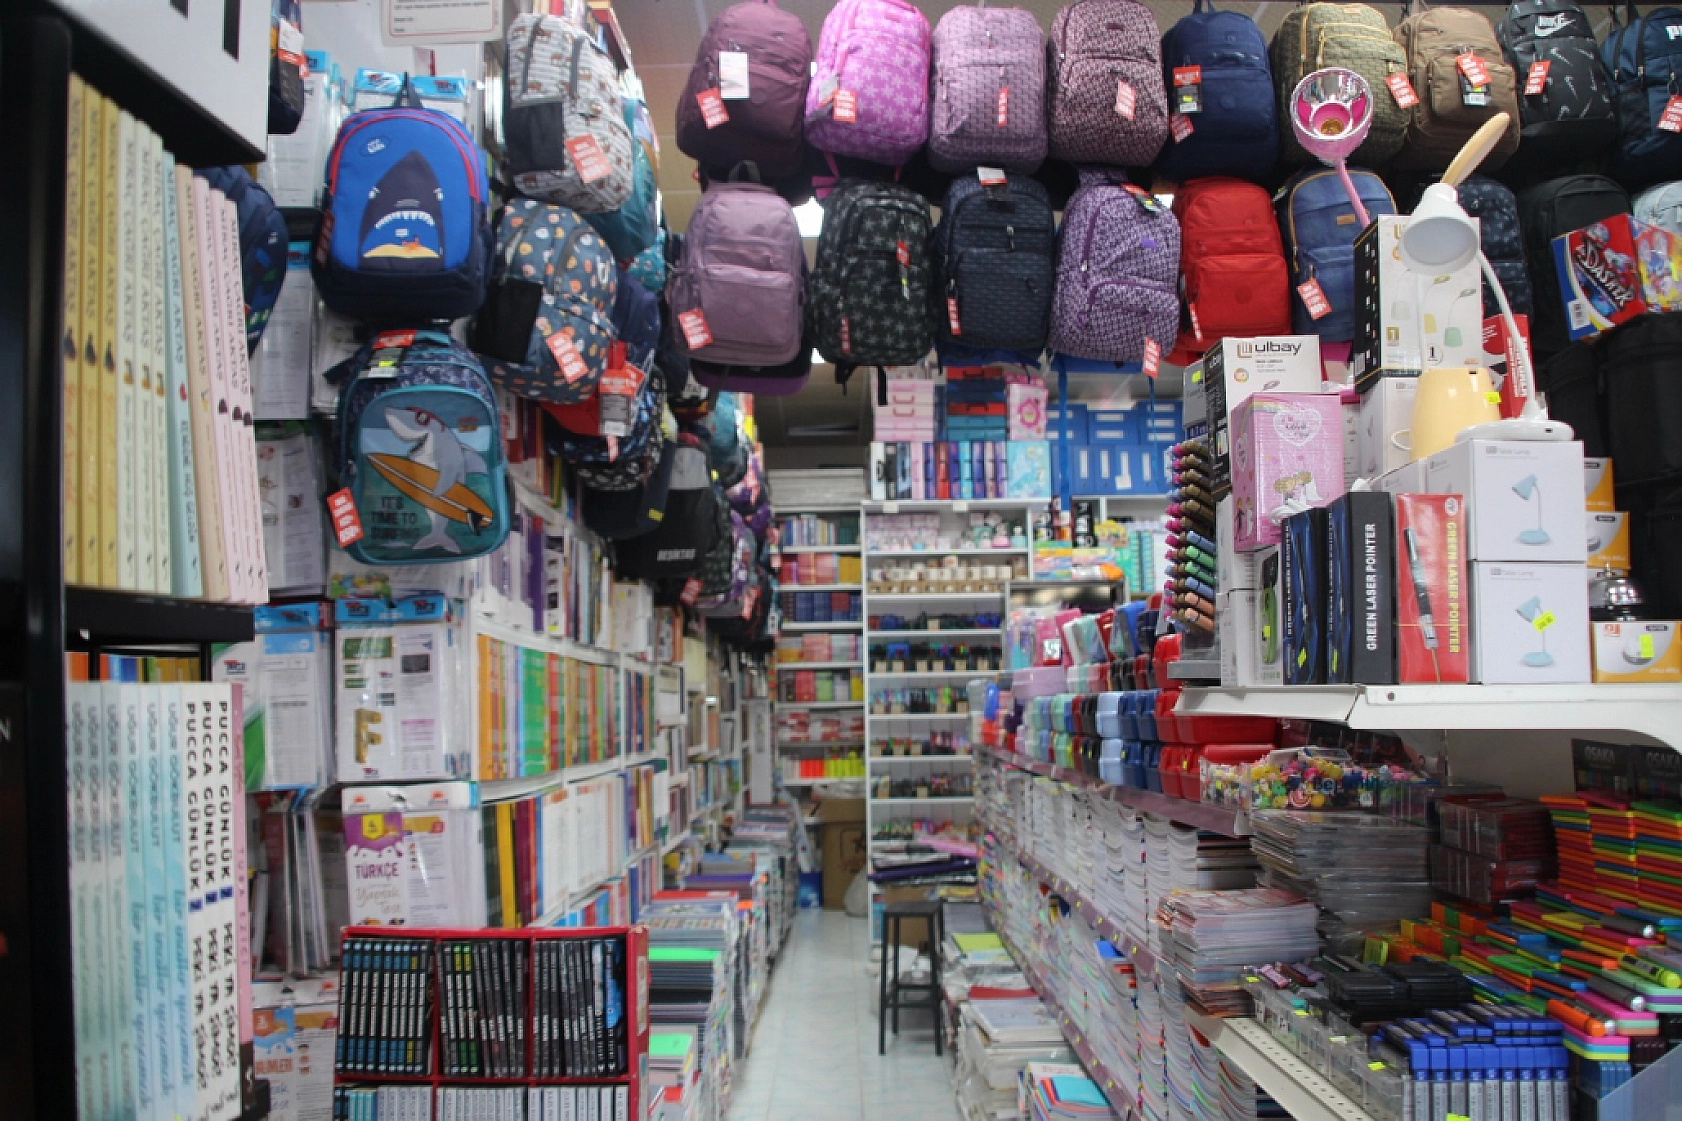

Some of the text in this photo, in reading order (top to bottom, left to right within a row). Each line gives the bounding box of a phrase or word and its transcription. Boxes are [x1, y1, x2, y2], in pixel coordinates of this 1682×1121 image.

[1537, 13, 1567, 27] NIKE
[371, 511, 417, 525] TIME TO
[1365, 523, 1378, 651] GREEN LASER POINTER
[1446, 522, 1460, 653] GREEN LASER POINTER
[186, 702, 198, 781] PUCCA
[203, 700, 212, 776] PUCCA
[219, 700, 229, 774] PUCCA
[188, 791, 201, 889] GÜNLÜK
[204, 787, 216, 886] GÜNLÜK
[220, 784, 232, 880] GÜNLÜK
[355, 862, 400, 881] TÜRKÇE
